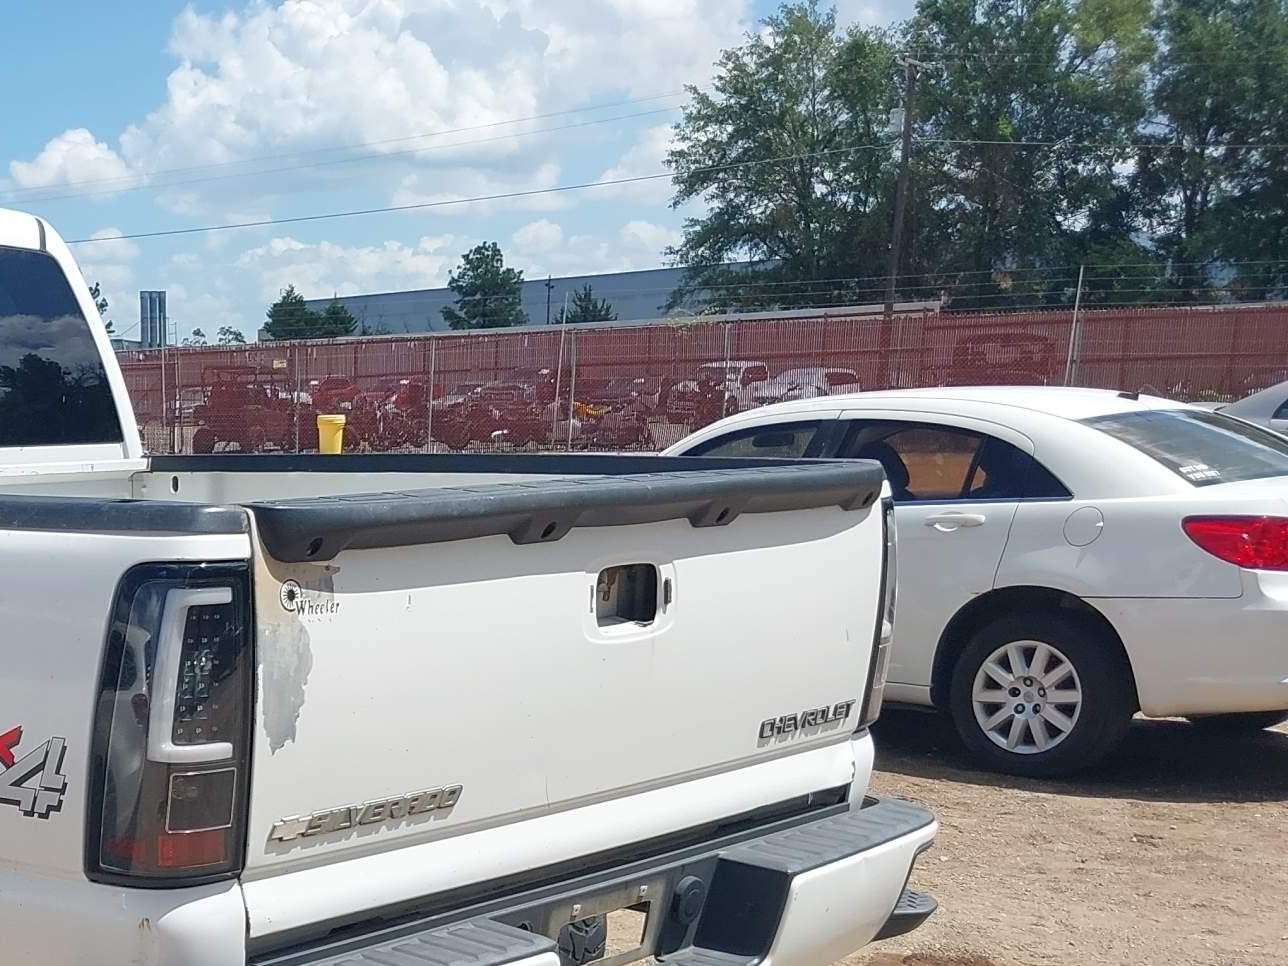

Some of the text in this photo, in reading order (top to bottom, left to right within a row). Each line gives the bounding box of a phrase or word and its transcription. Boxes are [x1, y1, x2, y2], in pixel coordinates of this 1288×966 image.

[295, 599, 340, 615] Wheeler
[758, 699, 857, 739] CHEVROLET
[302, 783, 464, 838] SILVERADO
